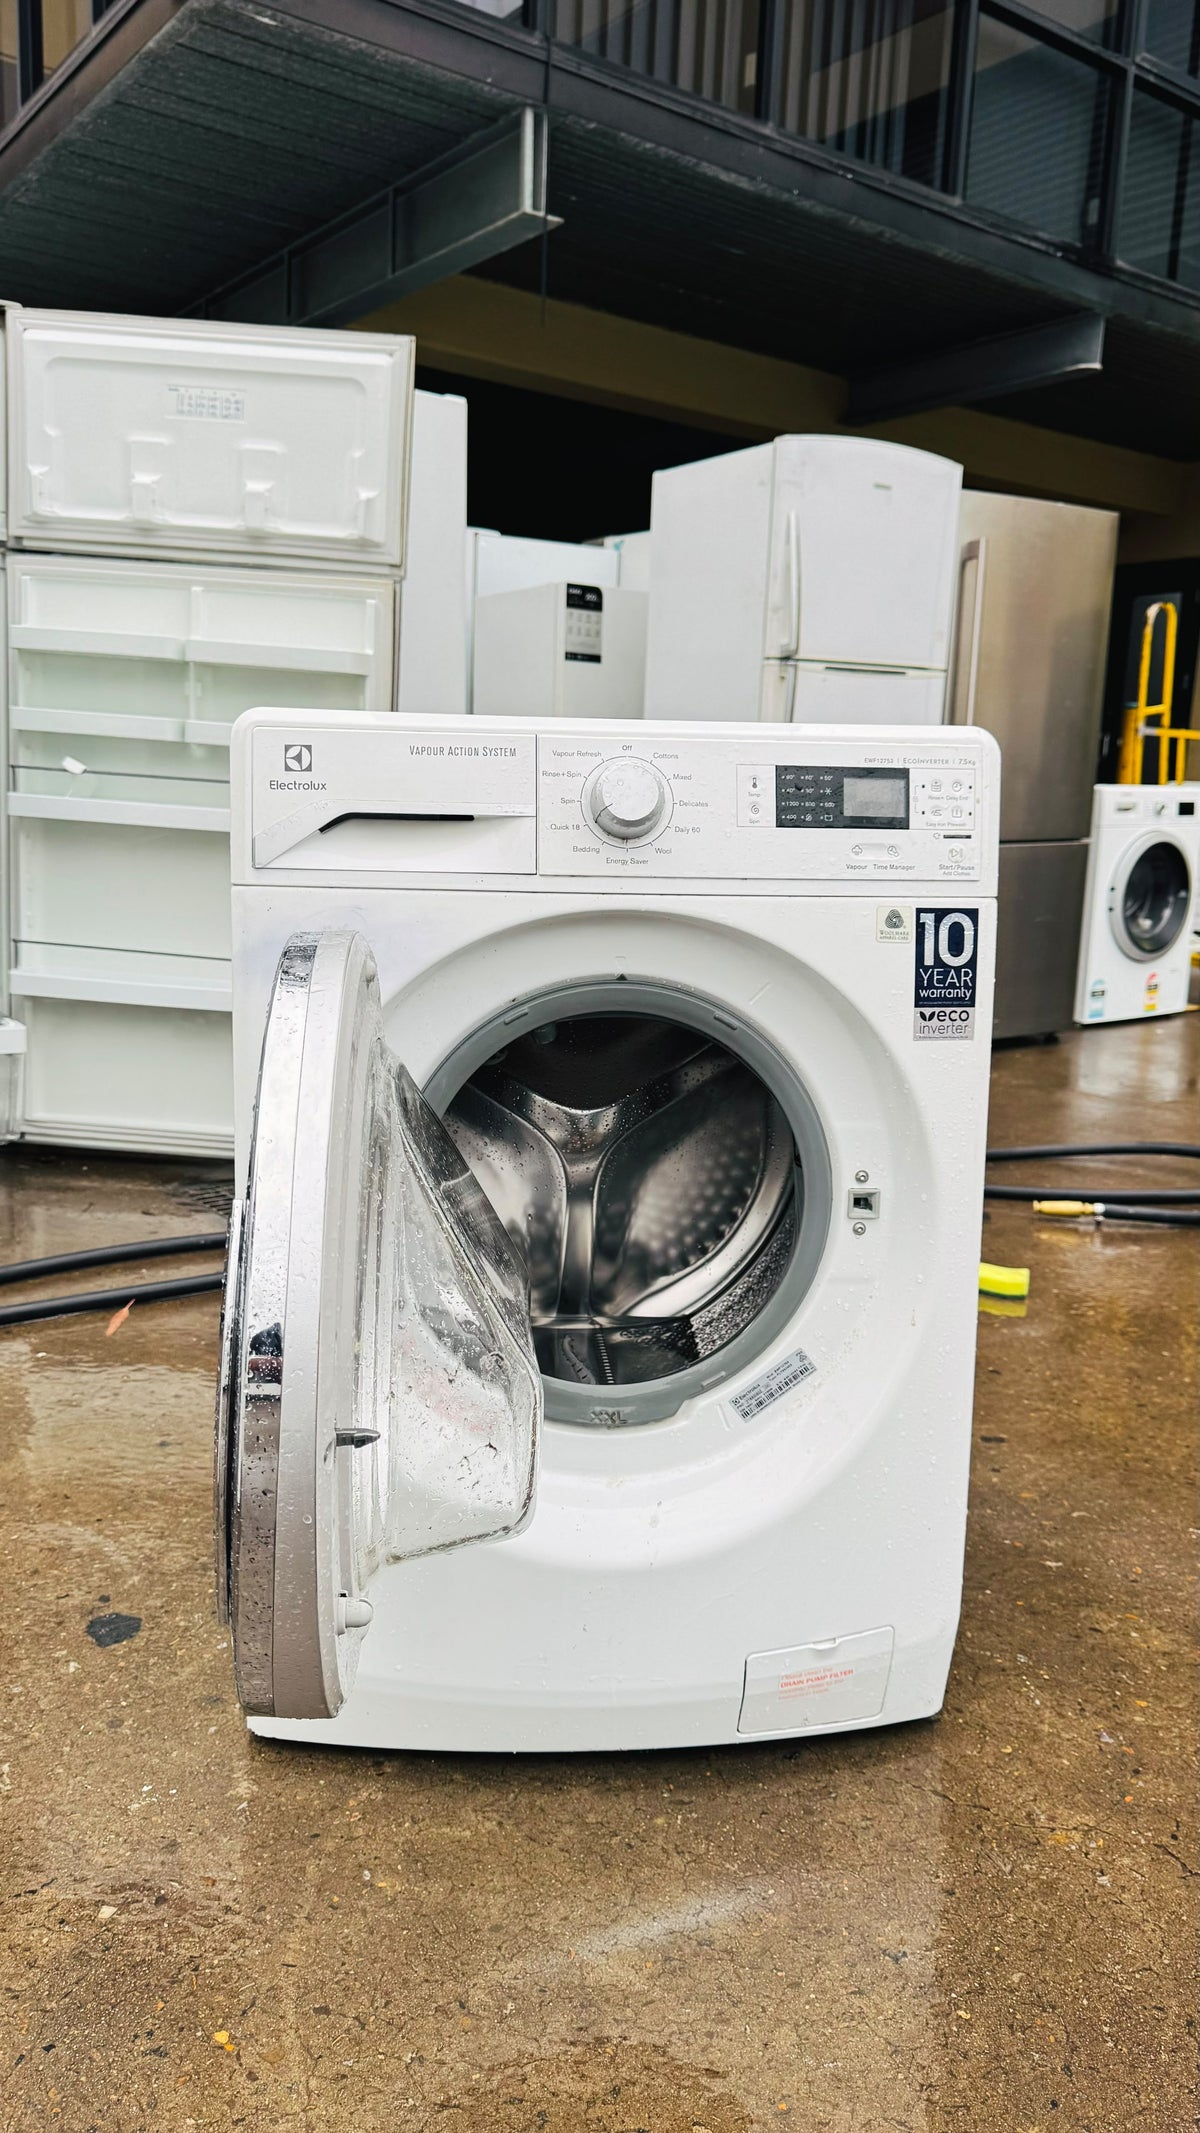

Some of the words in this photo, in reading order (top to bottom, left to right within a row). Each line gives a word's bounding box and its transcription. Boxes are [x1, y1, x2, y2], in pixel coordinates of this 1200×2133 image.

[409, 745, 445, 756] VAPOUR
[448, 746, 480, 757] ACTION
[482, 746, 517, 757] SYSTEM
[552, 750, 575, 758] Vapour
[653, 752, 679, 760] Cottons
[269, 780, 327, 791] Electrolux
[674, 826, 690, 834] Daily
[572, 846, 600, 854] Bedding
[606, 858, 628, 866] Energy
[846, 863, 868, 871] Vapour
[888, 864, 916, 872] Manager
[920, 912, 974, 967] 10
[920, 968, 973, 987] YEAR
[920, 986, 972, 1000] warranty
[936, 1010, 970, 1022] eco
[919, 1022, 968, 1034] inverter
[781, 1680, 804, 1688] DRAIN
[806, 1676, 828, 1684] PUMP
[829, 1669, 854, 1679] FILTER
